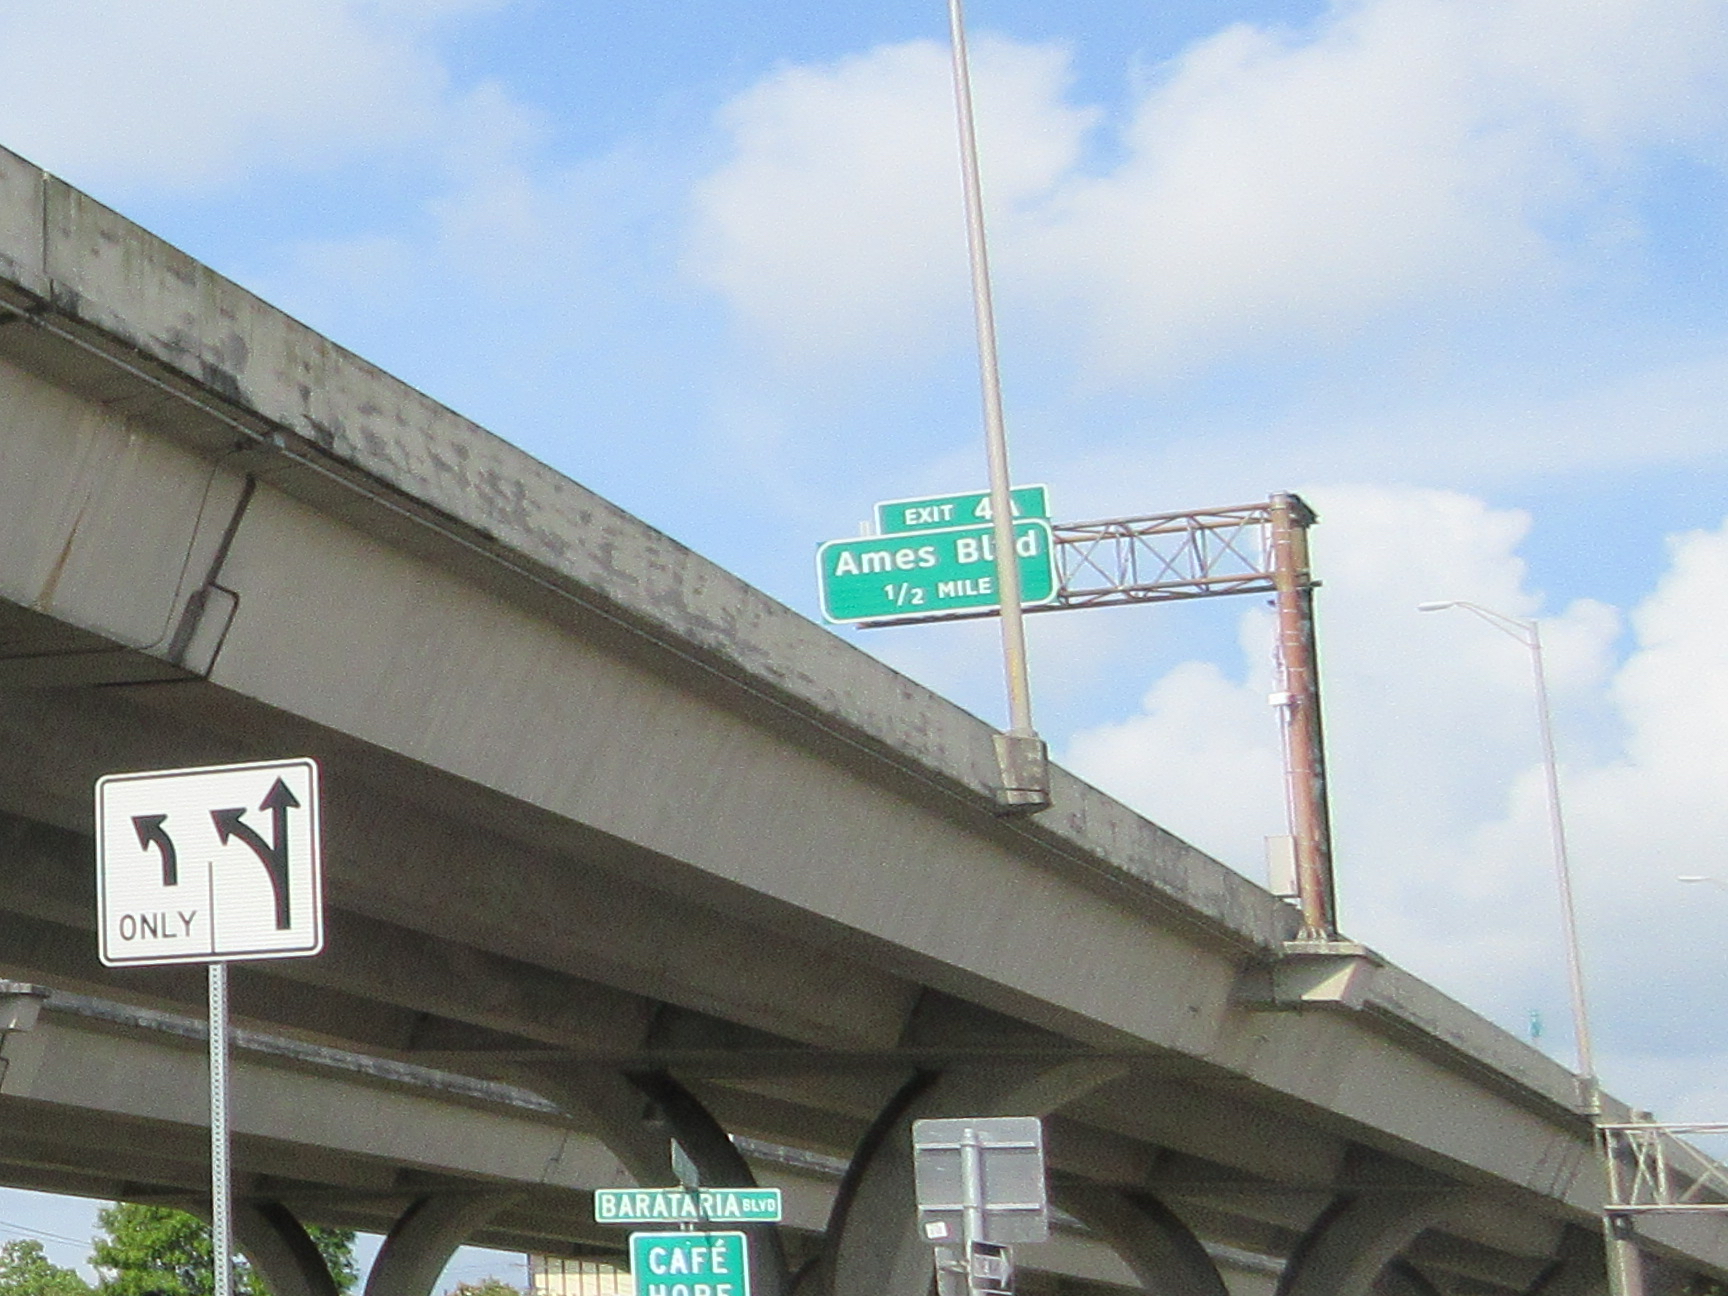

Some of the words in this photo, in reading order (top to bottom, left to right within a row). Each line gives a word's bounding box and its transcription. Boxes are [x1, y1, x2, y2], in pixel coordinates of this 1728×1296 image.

[905, 504, 953, 525] EXIT
[835, 546, 937, 576] Ames
[956, 530, 1038, 564] Bld
[884, 582, 924, 605] 1/2
[938, 577, 992, 599] MILE
[119, 910, 197, 942] ONLY
[601, 1193, 741, 1218] BARATARIA
[742, 1198, 776, 1212] BLVD
[649, 1239, 729, 1275] CAFÉ
